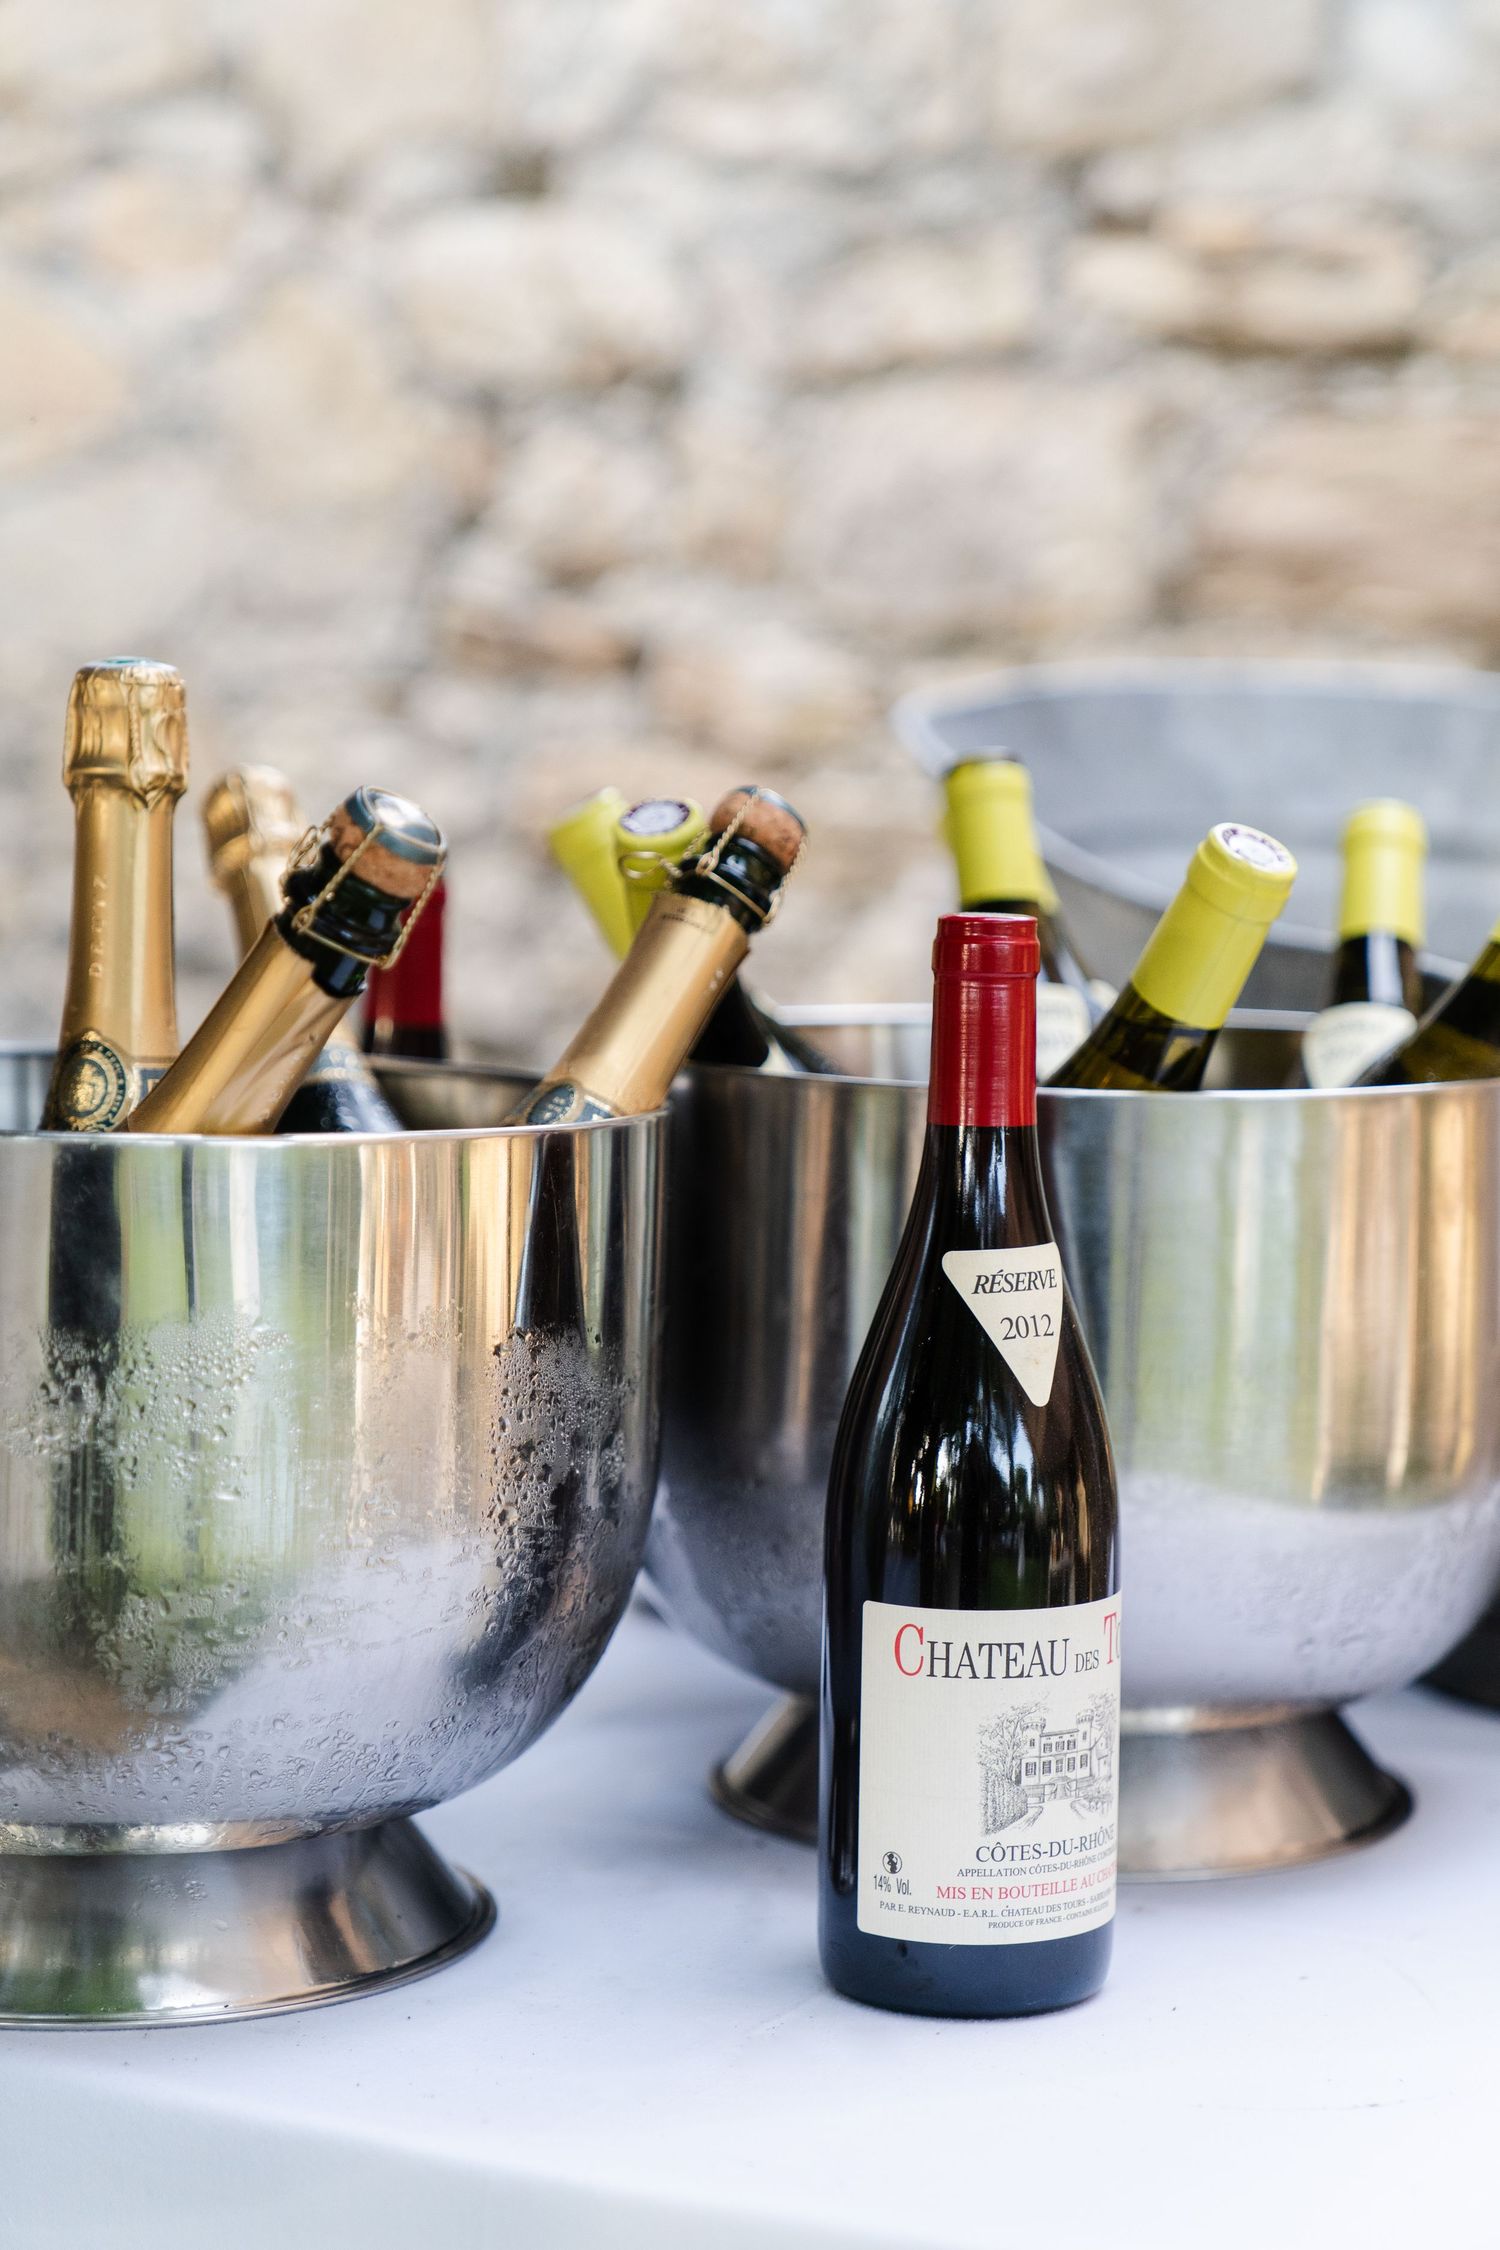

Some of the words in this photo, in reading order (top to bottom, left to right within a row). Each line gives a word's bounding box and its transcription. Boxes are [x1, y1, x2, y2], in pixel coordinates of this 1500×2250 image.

[971, 1269, 1057, 1294] RÉSERVE
[1000, 1314, 1054, 1341] 2012
[894, 1623, 1070, 1680] CHATEAU
[1074, 1649, 1099, 1673] DES
[976, 1824, 1115, 1862] CÔTES-DU-RHÔNE
[957, 1866, 1027, 1878] APPELLATION
[873, 1874, 892, 1893] 14%
[896, 1878, 912, 1896] Vol.
[936, 1886, 967, 1900] MIS
[971, 1887, 994, 1900] EN
[998, 1878, 1078, 1900] BOUTEILLE
[1080, 1873, 1096, 1889] AU
[880, 1900, 897, 1911] PAR
[898, 1904, 906, 1912] E.
[908, 1906, 956, 1917] REYNAUD
[1001, 1906, 1045, 1918] CHATEAU
[1046, 1903, 1062, 1913] DES
[1063, 1898, 1086, 1910] TOURS
[988, 1920, 1024, 1929] PRODUCE
[1025, 1918, 1034, 1927] OF
[1036, 1915, 1062, 1925] FRANCE
